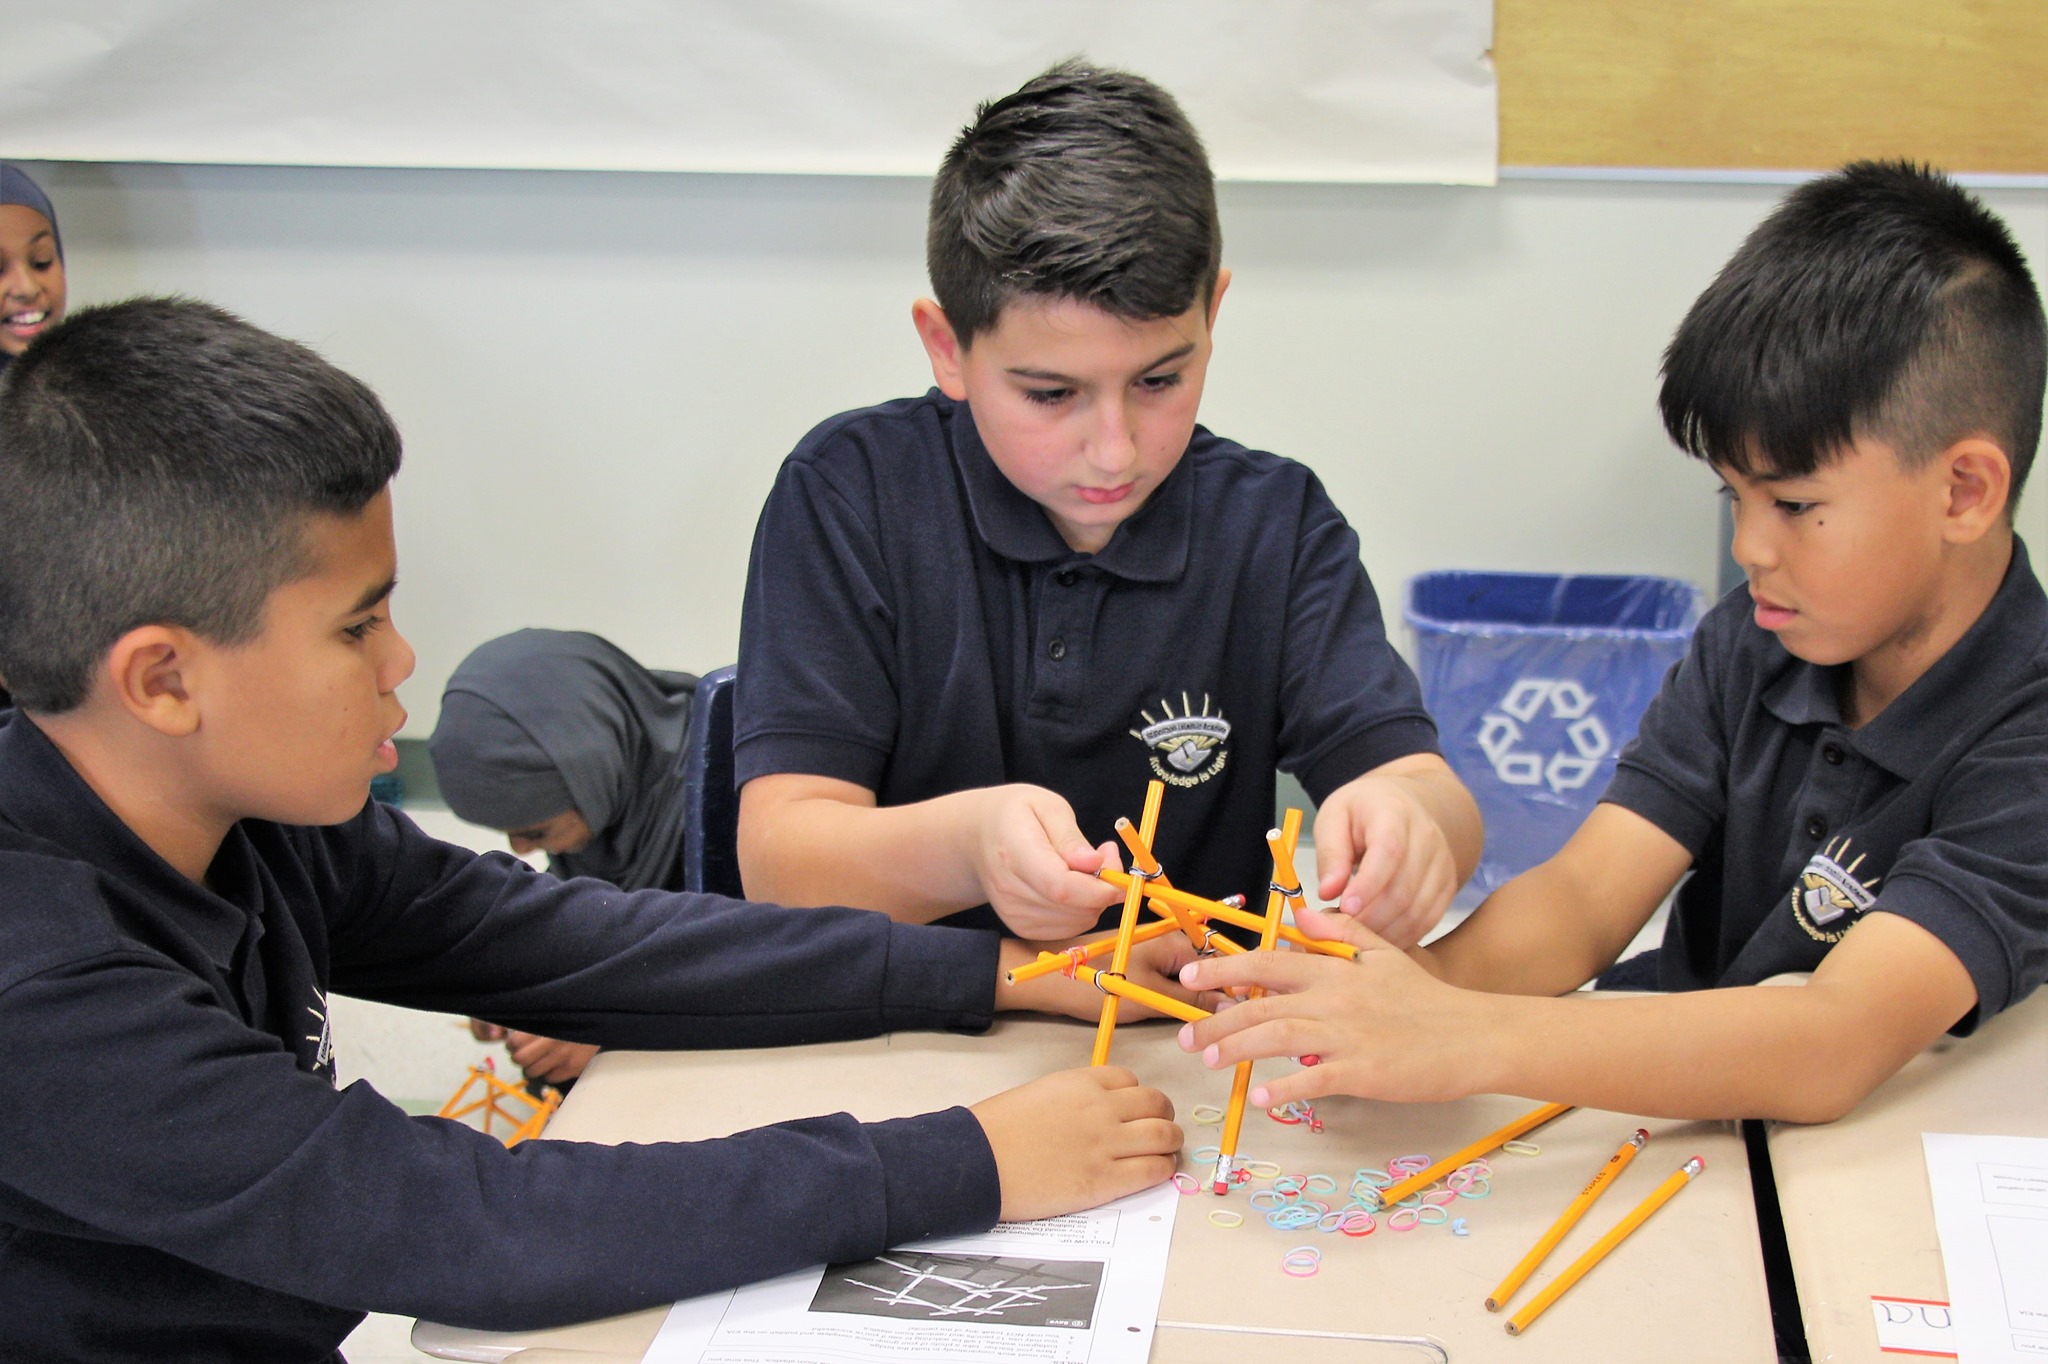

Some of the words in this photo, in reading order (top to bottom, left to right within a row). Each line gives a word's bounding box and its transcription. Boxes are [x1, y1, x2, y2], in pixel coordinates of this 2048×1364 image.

[1149, 755, 1199, 788] Knowledge
[1199, 772, 1210, 783] is
[1581, 1172, 1606, 1195] STAPLES
